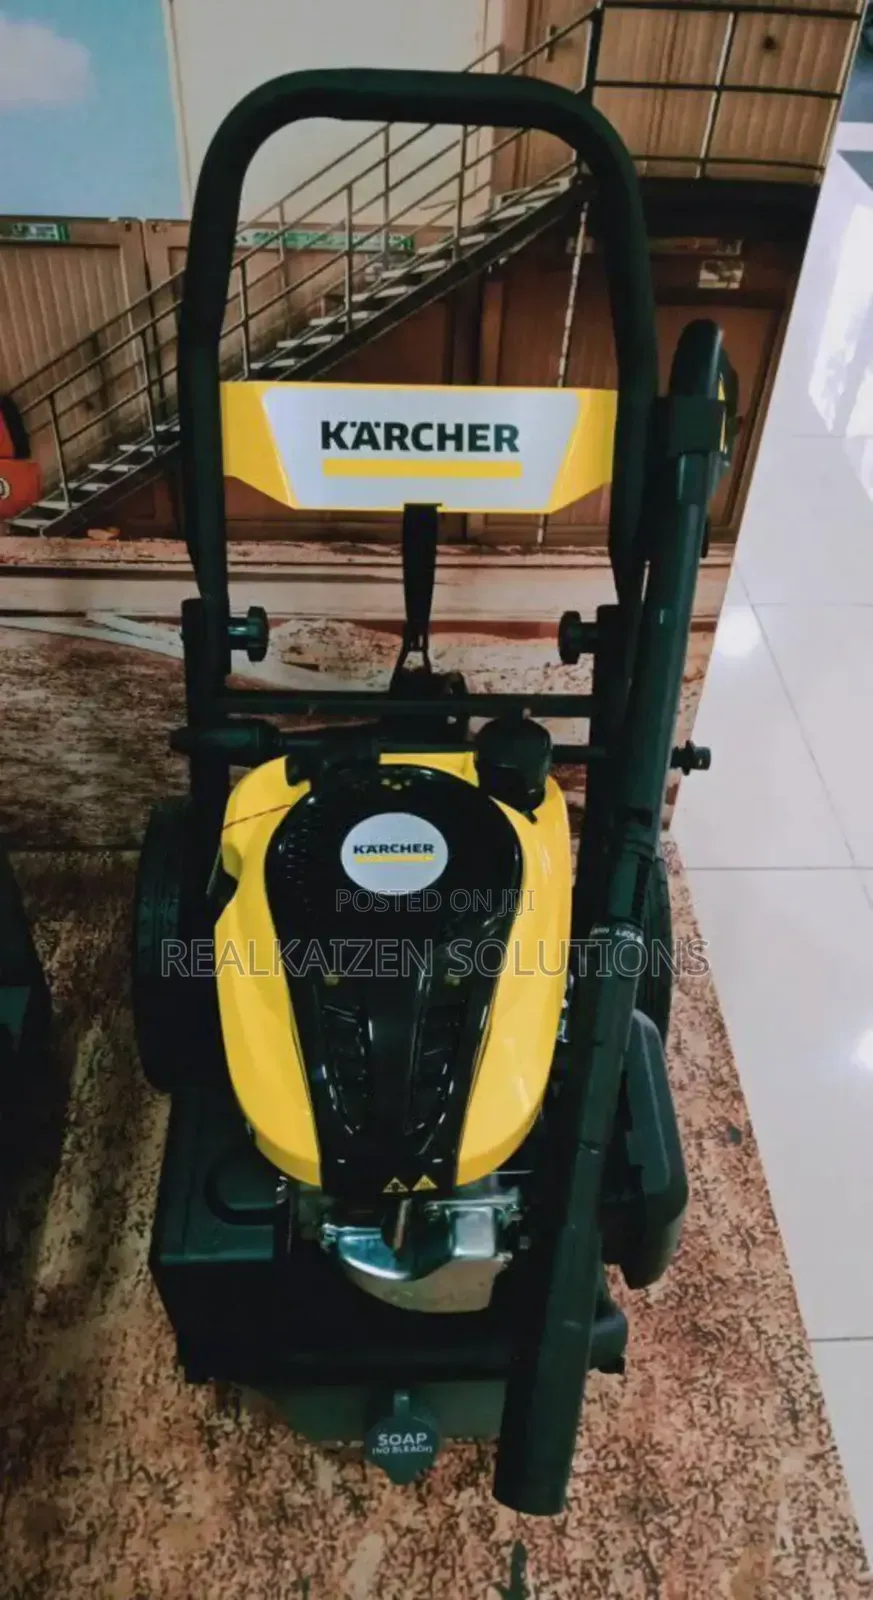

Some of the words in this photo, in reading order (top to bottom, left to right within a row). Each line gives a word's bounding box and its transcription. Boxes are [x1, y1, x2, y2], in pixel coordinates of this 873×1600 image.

[320, 420, 521, 453] KÄRCHER
[353, 843, 435, 854] KÄRCHER
[378, 1432, 428, 1446] SOAP
